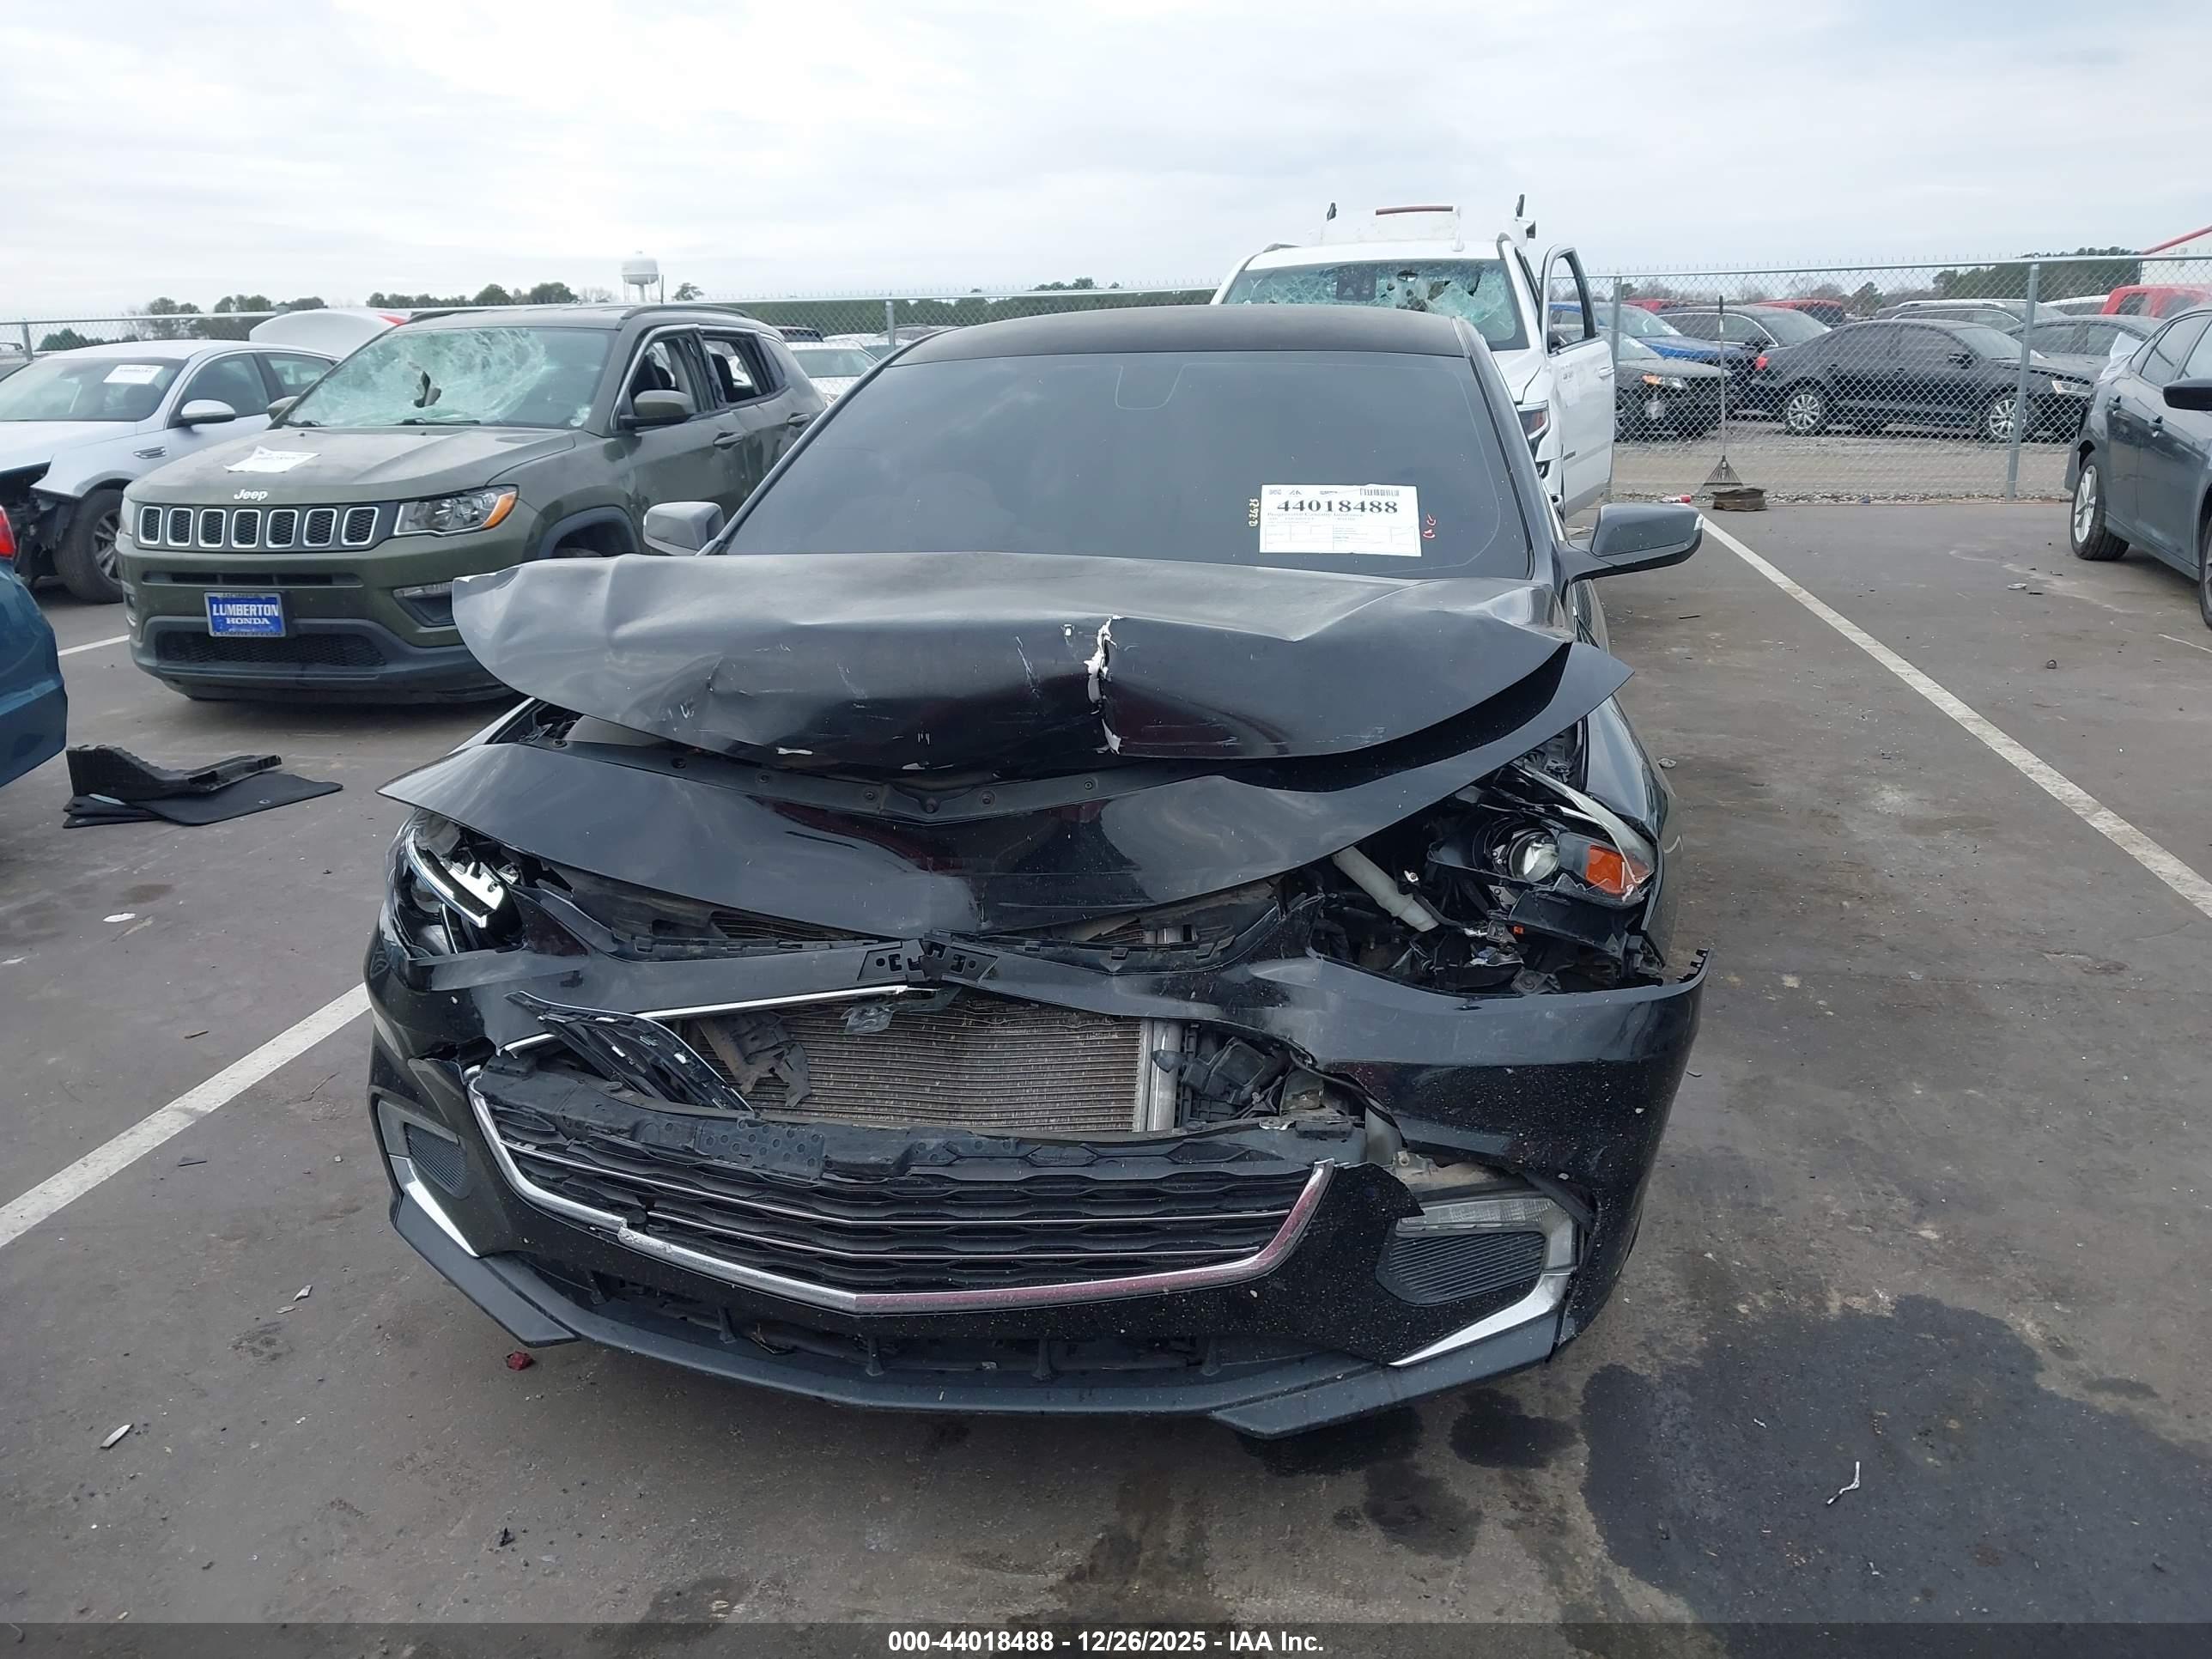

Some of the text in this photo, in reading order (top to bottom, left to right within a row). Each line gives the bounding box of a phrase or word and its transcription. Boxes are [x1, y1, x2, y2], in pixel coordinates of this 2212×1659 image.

[234, 489, 268, 501] Jeep
[1277, 500, 1398, 514] 44018488
[212, 604, 279, 617] LUMBERTON
